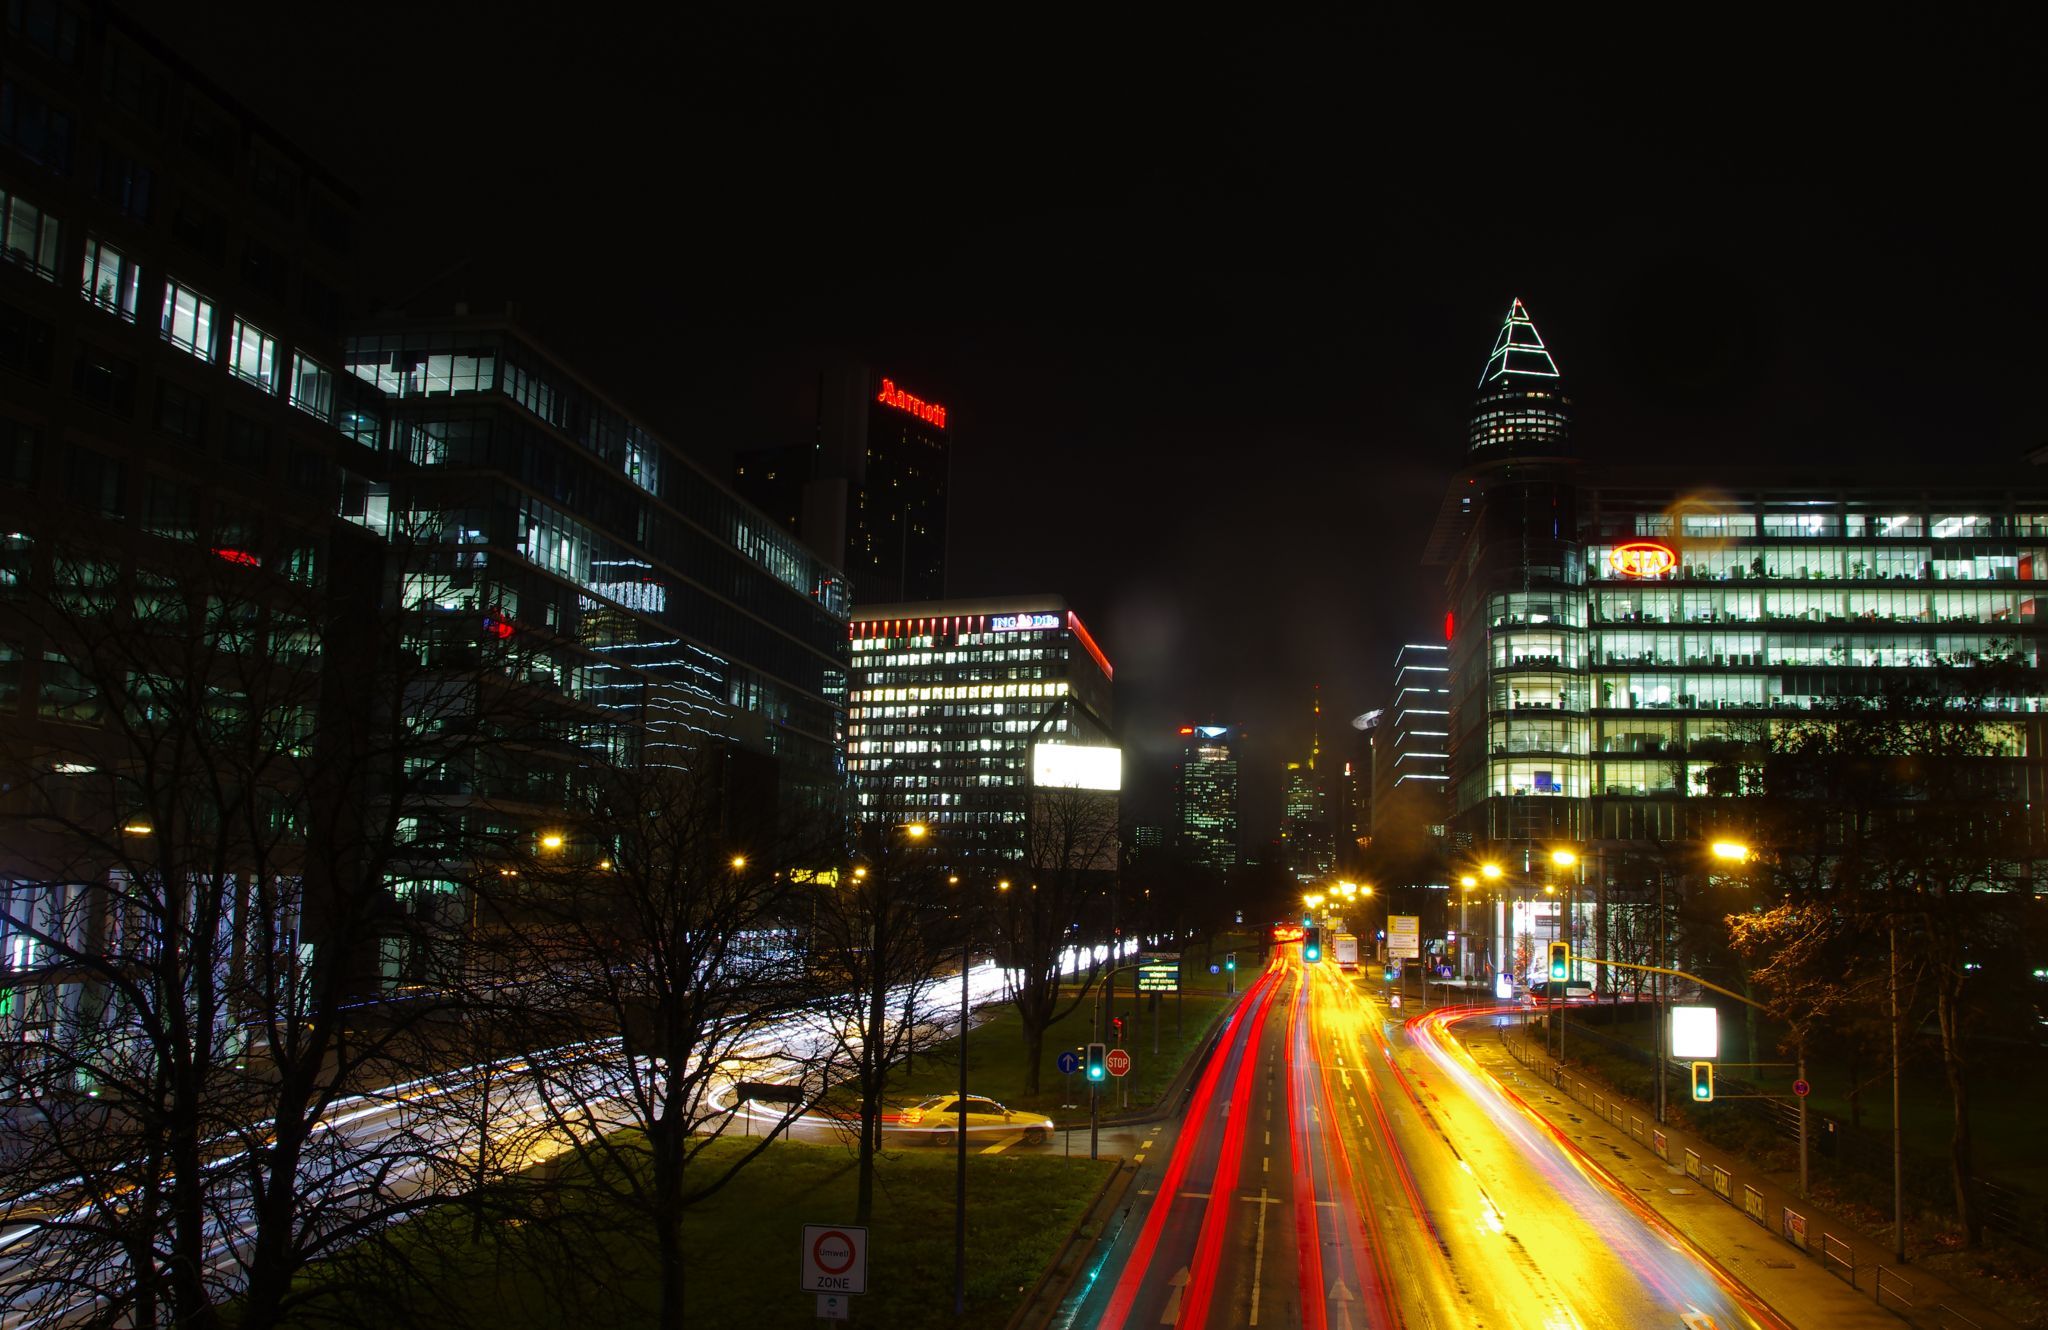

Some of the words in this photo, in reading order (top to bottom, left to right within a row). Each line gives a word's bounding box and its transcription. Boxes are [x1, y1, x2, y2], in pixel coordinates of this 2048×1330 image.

[878, 379, 946, 428] Marriott
[1622, 550, 1664, 568] KIA
[992, 616, 1016, 628] ING
[1108, 1057, 1128, 1068] STOP
[819, 1248, 849, 1258] Umwelt
[817, 1276, 850, 1289] ZONE
